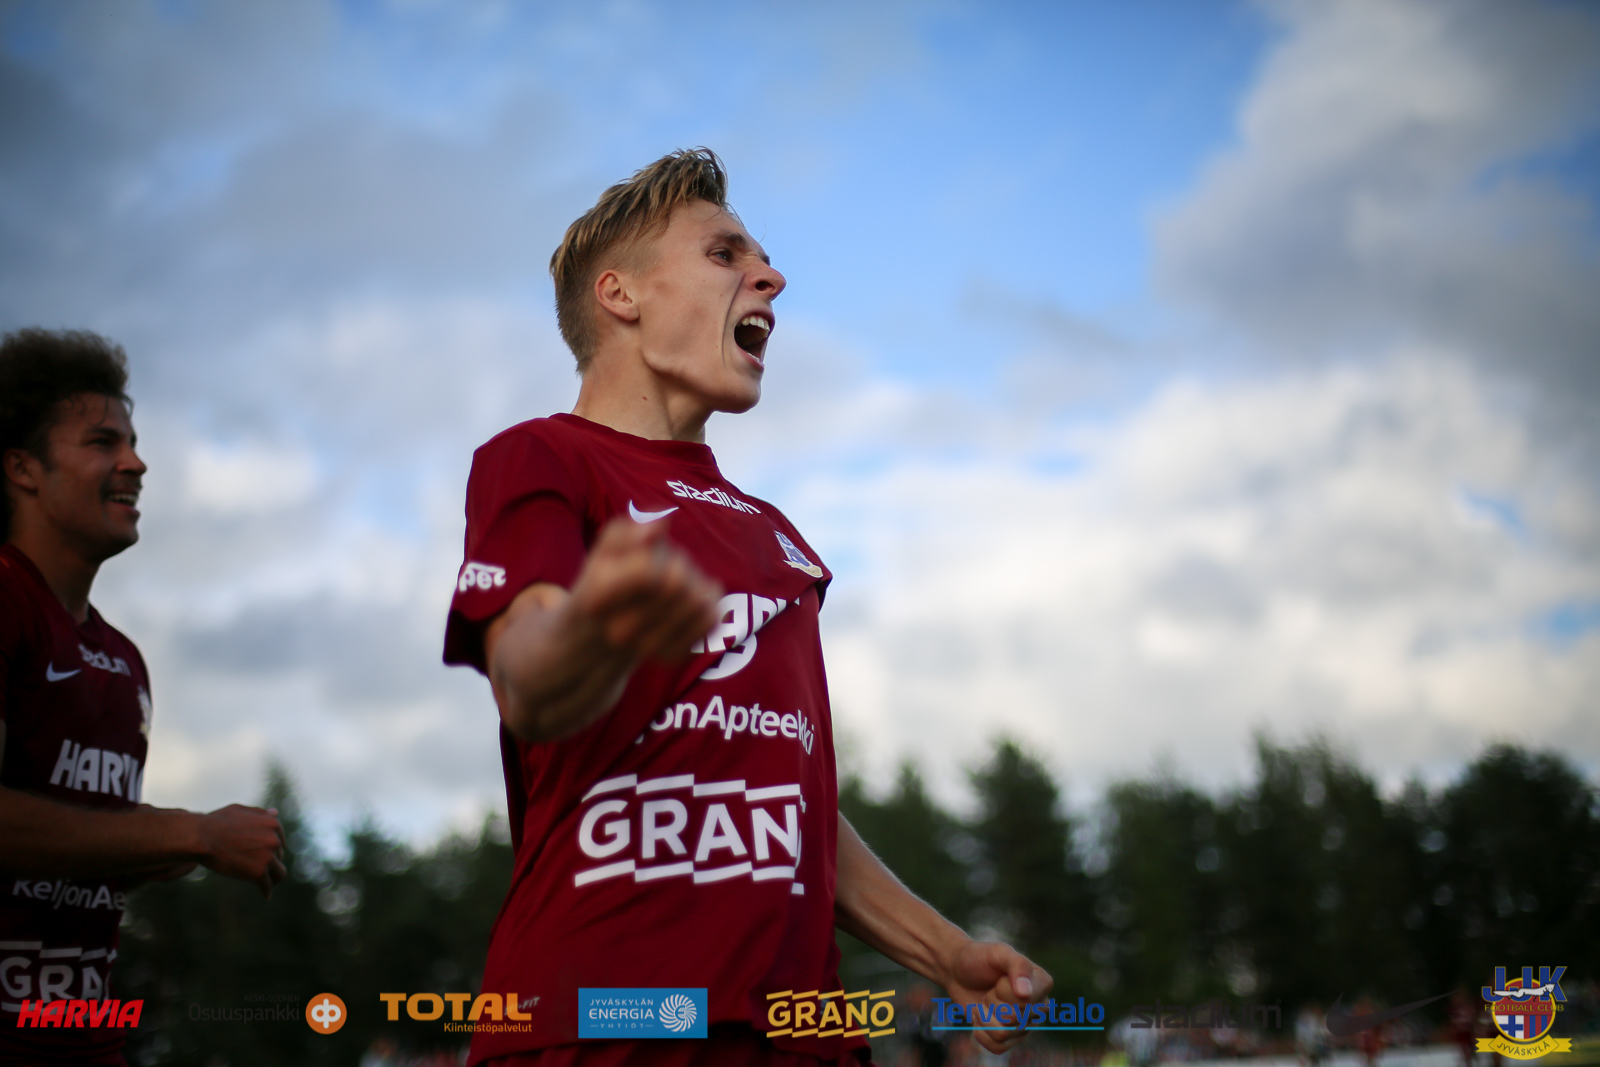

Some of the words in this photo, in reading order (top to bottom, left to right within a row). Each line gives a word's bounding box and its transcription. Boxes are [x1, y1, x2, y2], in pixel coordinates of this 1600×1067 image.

[667, 480, 761, 515] stadium
[635, 695, 815, 756] onApteekki
[578, 798, 802, 868] GRAN
[0, 955, 111, 1002] GRA
